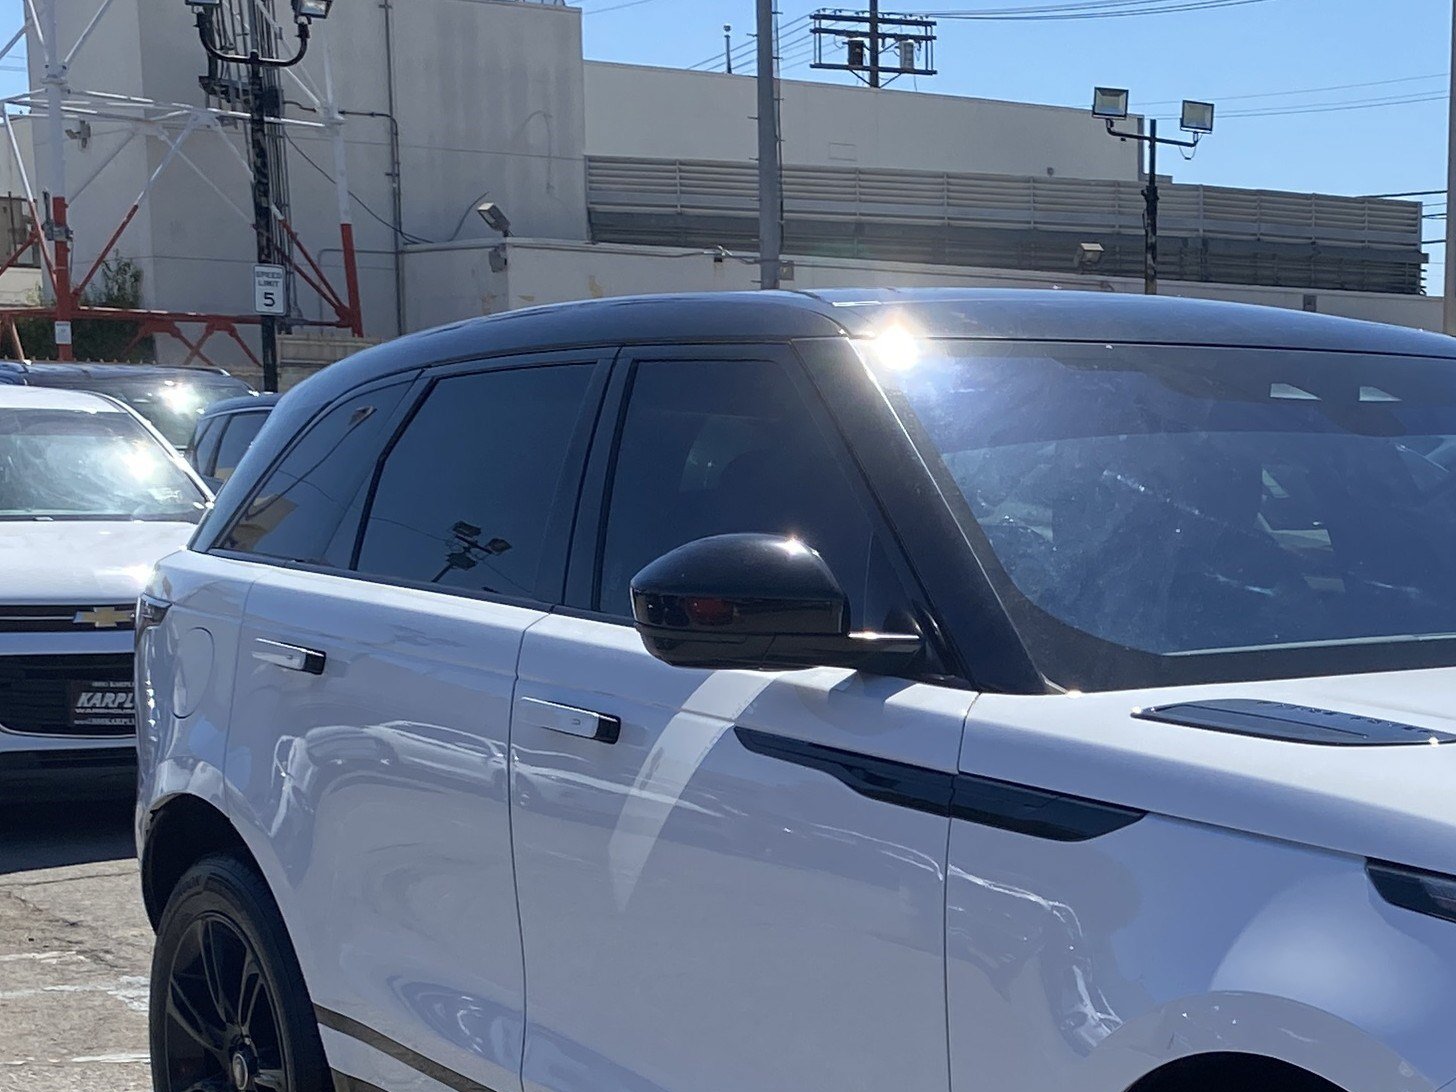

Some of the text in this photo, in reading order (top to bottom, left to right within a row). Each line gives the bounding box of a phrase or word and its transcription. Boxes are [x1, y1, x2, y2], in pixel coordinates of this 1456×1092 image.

[256, 271, 283, 279] SPEED
[264, 292, 275, 307] 5
[76, 692, 134, 707] KARPL
